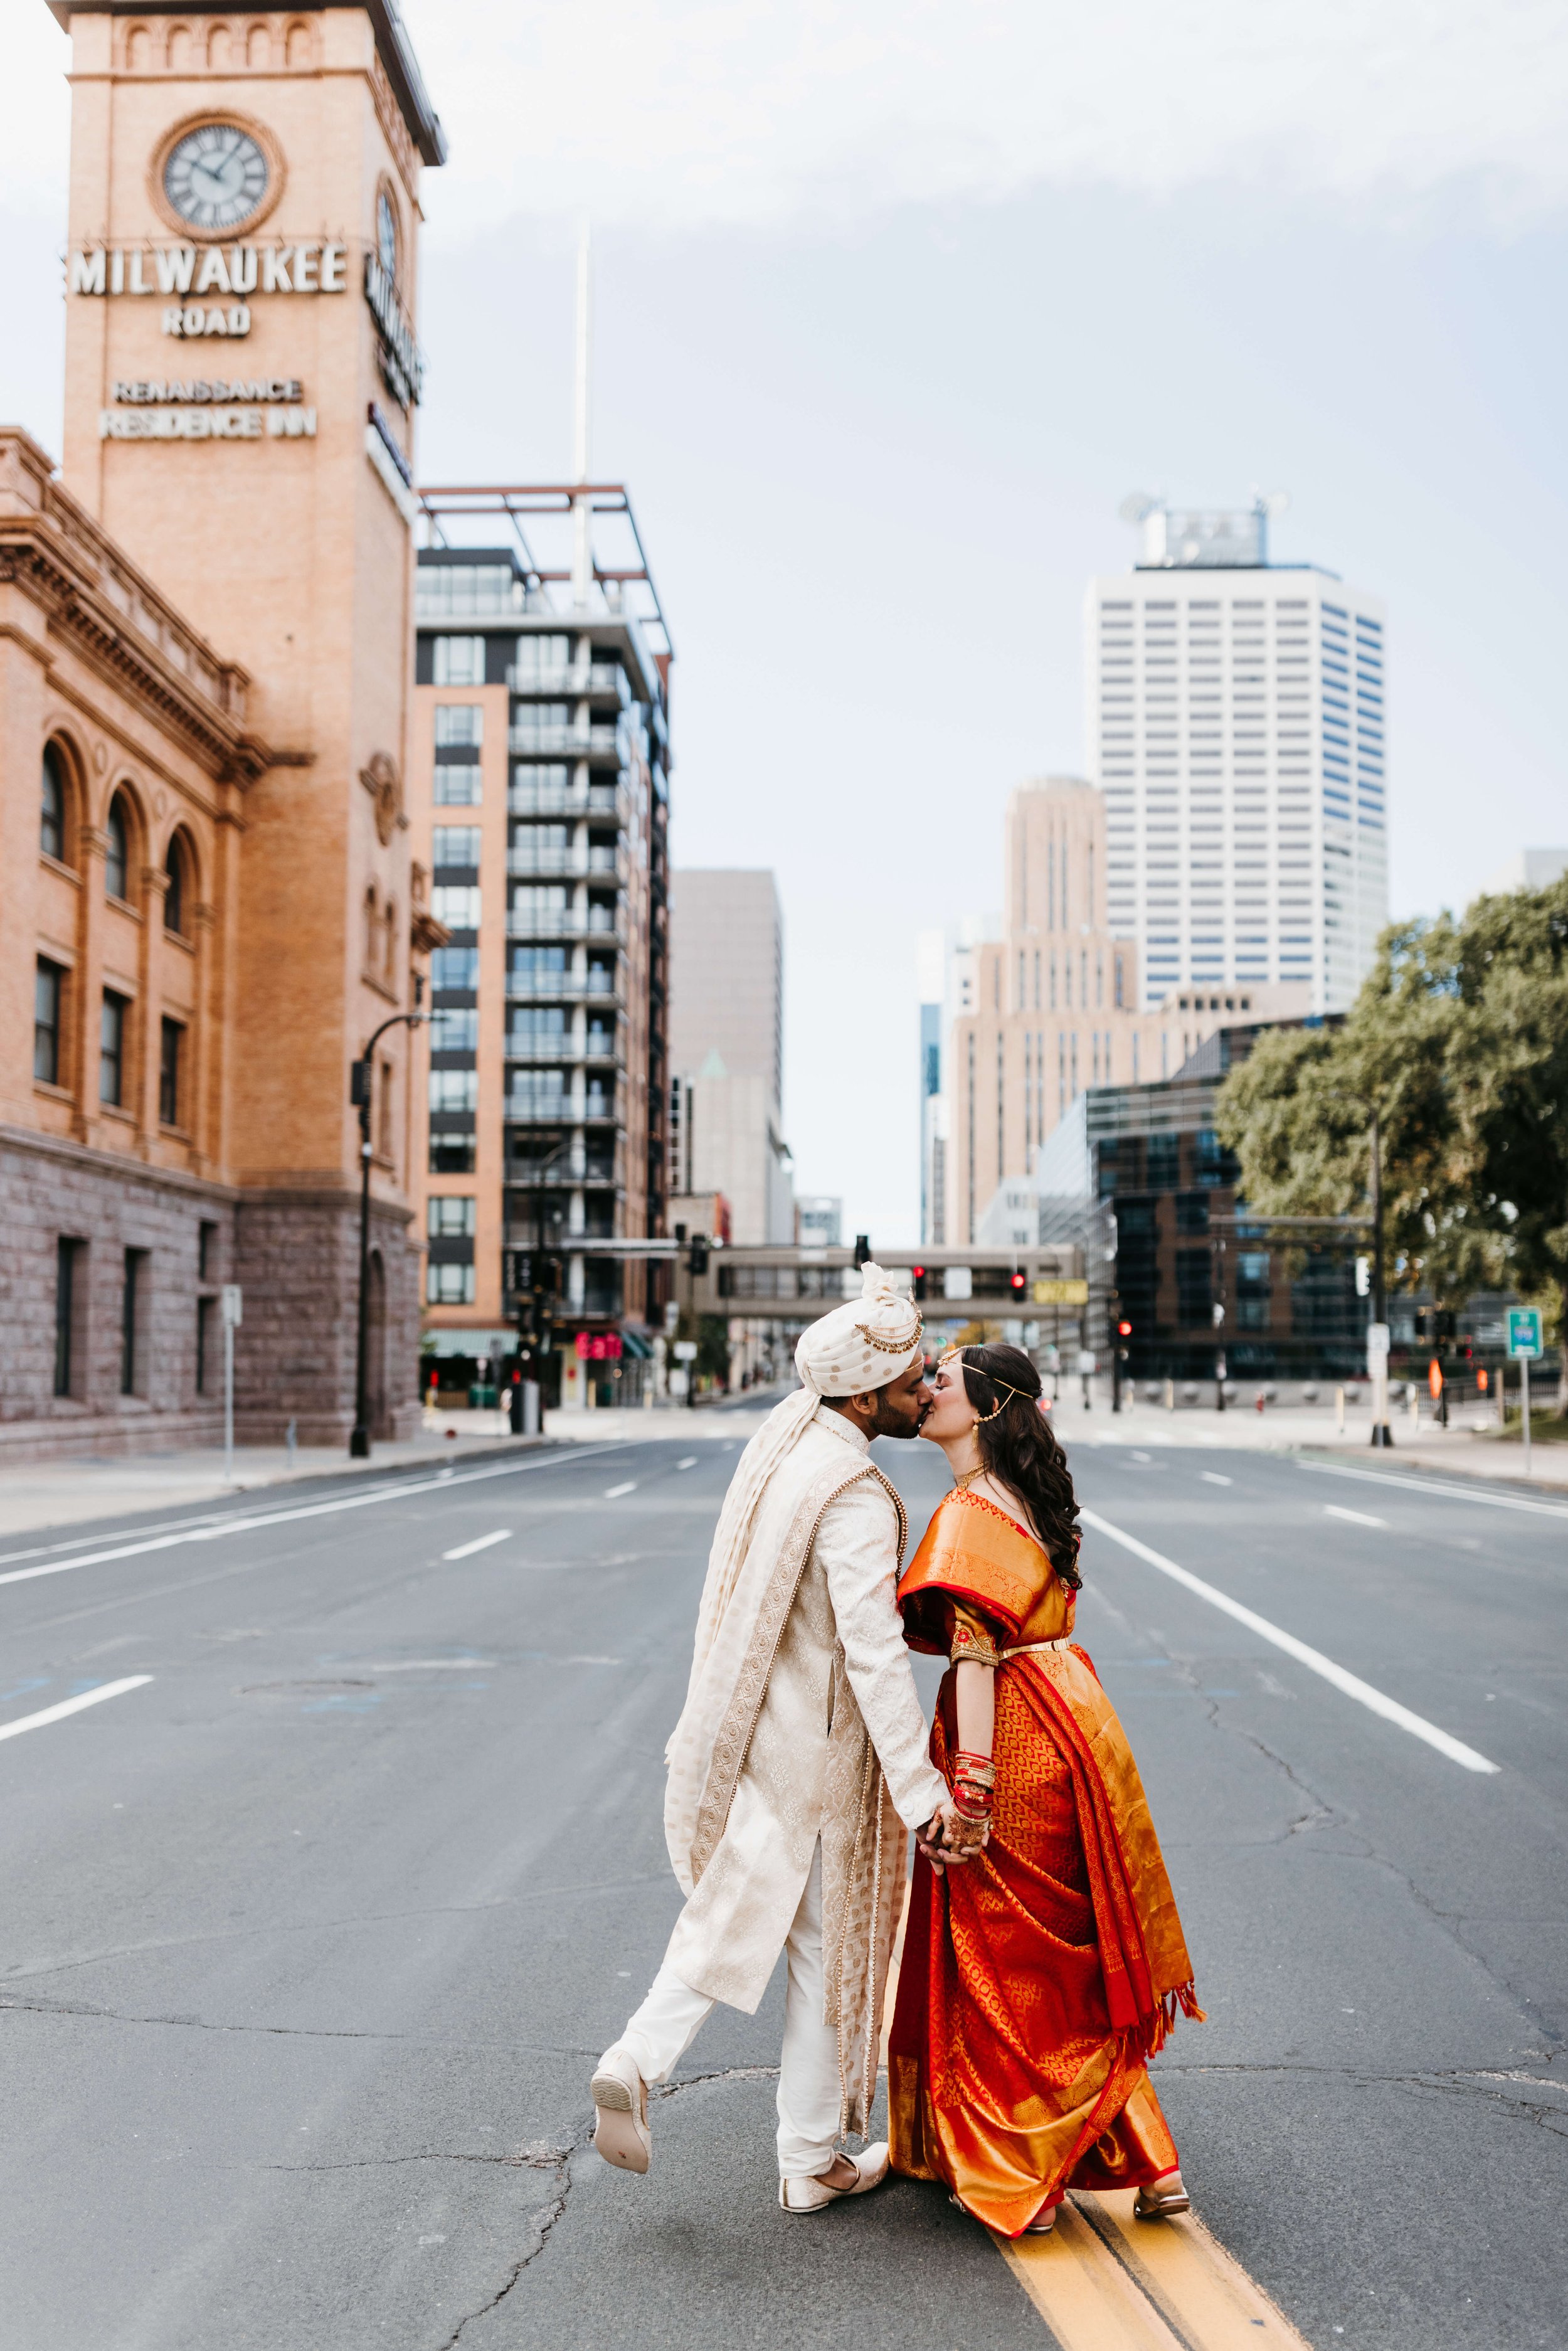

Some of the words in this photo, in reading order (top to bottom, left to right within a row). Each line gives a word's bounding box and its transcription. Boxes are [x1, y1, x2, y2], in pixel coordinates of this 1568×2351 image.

[72, 244, 347, 295] MILWAUKEE
[161, 304, 251, 337] ROAD
[114, 379, 303, 402] RENAISSANCE
[100, 408, 262, 438] RESIDENCE
[267, 405, 317, 438] INN
